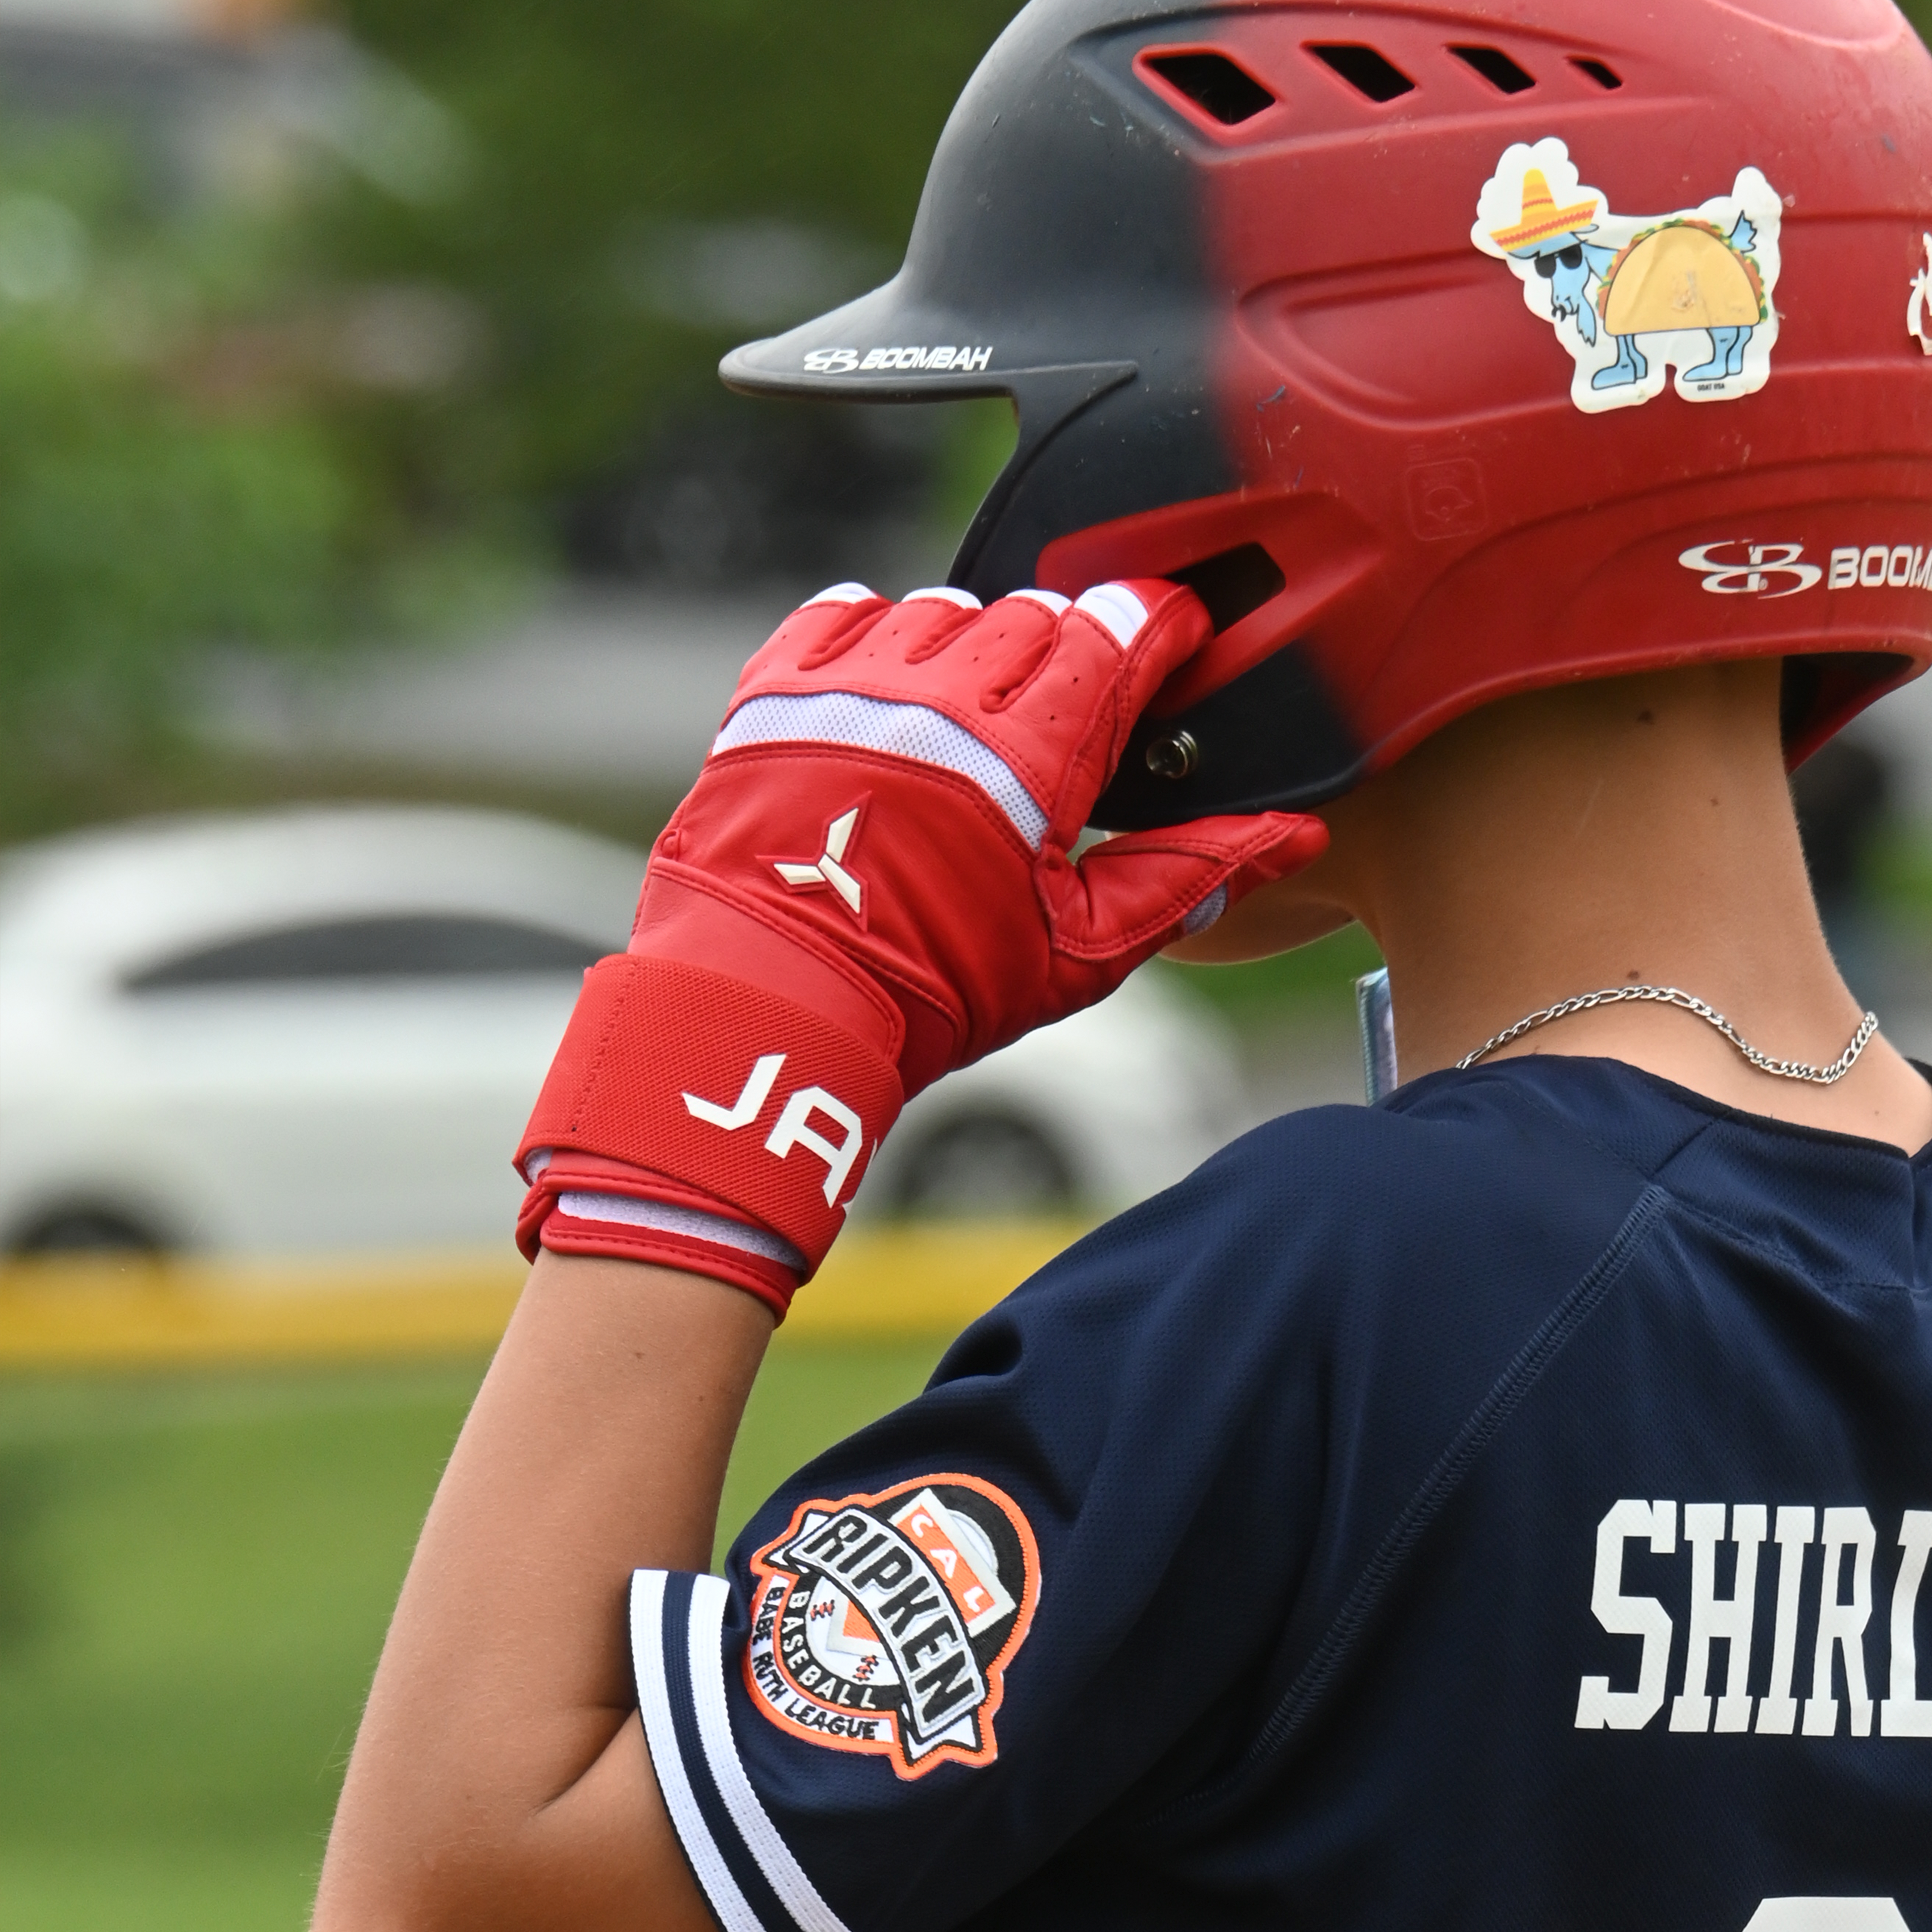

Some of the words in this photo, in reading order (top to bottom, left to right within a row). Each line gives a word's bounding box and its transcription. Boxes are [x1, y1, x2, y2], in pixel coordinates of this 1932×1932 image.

[859, 346, 993, 371] BOOMBAH
[1827, 545, 1932, 591] BOOM
[682, 1053, 878, 1208] JA
[911, 1513, 986, 1612] CAL
[752, 1586, 787, 1646] BABE
[802, 1514, 976, 1723] RIPKEN
[752, 1651, 789, 1703] RUTH
[780, 1591, 876, 1709] BASEBALL
[784, 1698, 879, 1740] LEAGUE
